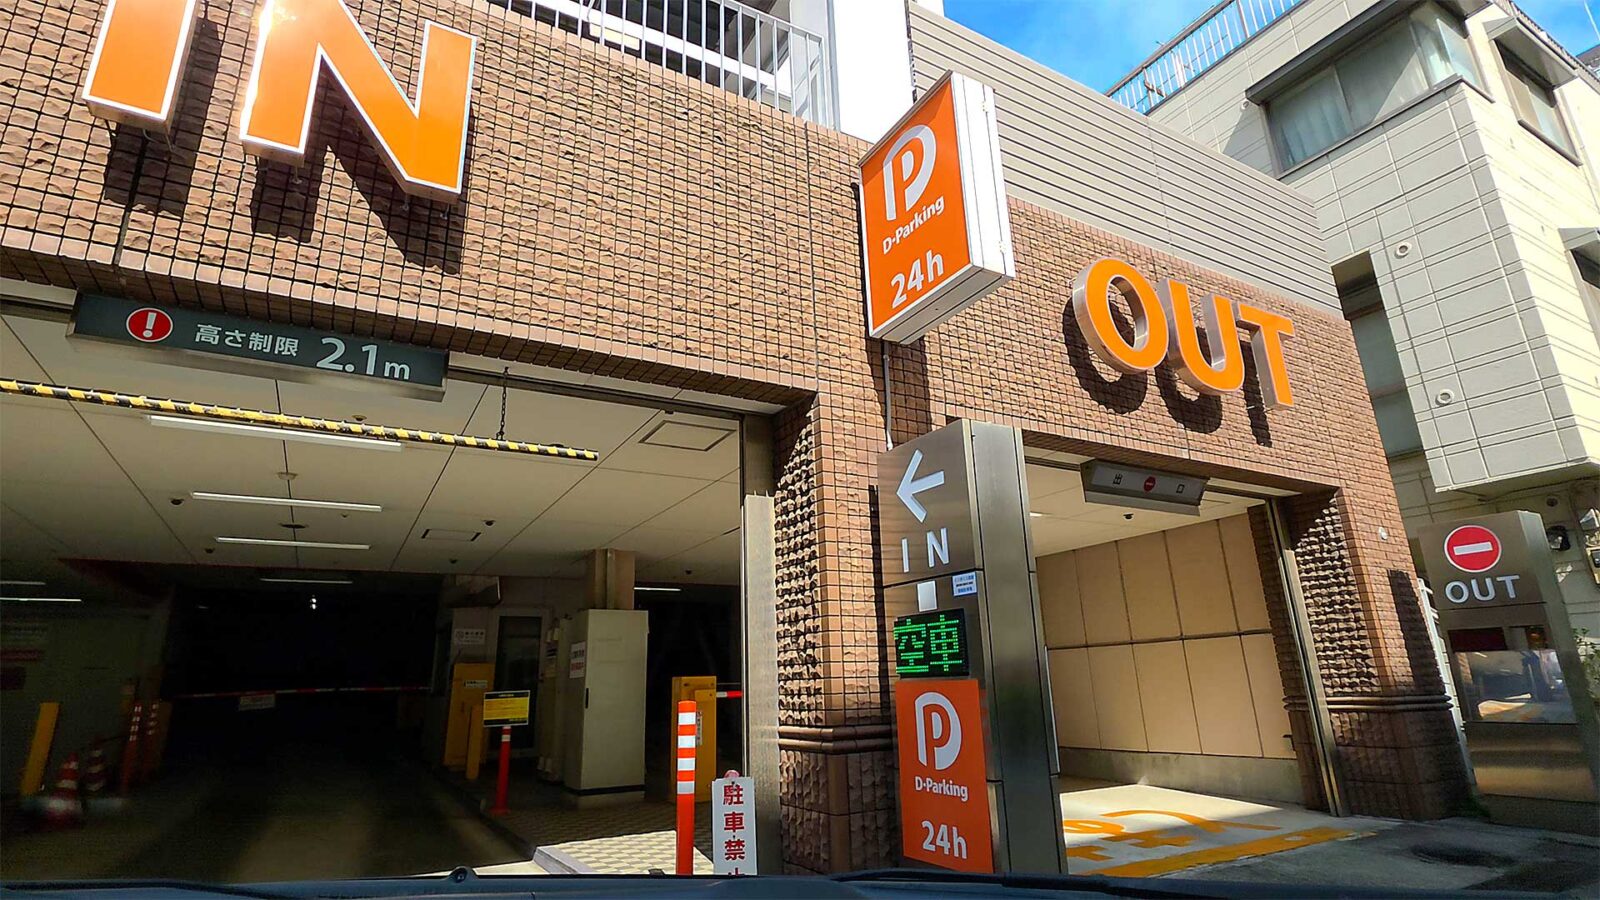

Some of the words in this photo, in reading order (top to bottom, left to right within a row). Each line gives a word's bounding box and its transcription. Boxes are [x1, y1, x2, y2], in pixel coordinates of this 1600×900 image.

[82, 0, 477, 194] IN
[890, 249, 944, 309] 24h
[194, 323, 299, 357] 高さ制限
[1076, 256, 1295, 408] OUT
[901, 527, 950, 573] IN
[1445, 574, 1521, 604] OUT
[893, 614, 962, 674] 空車
[921, 820, 968, 860] 24h
